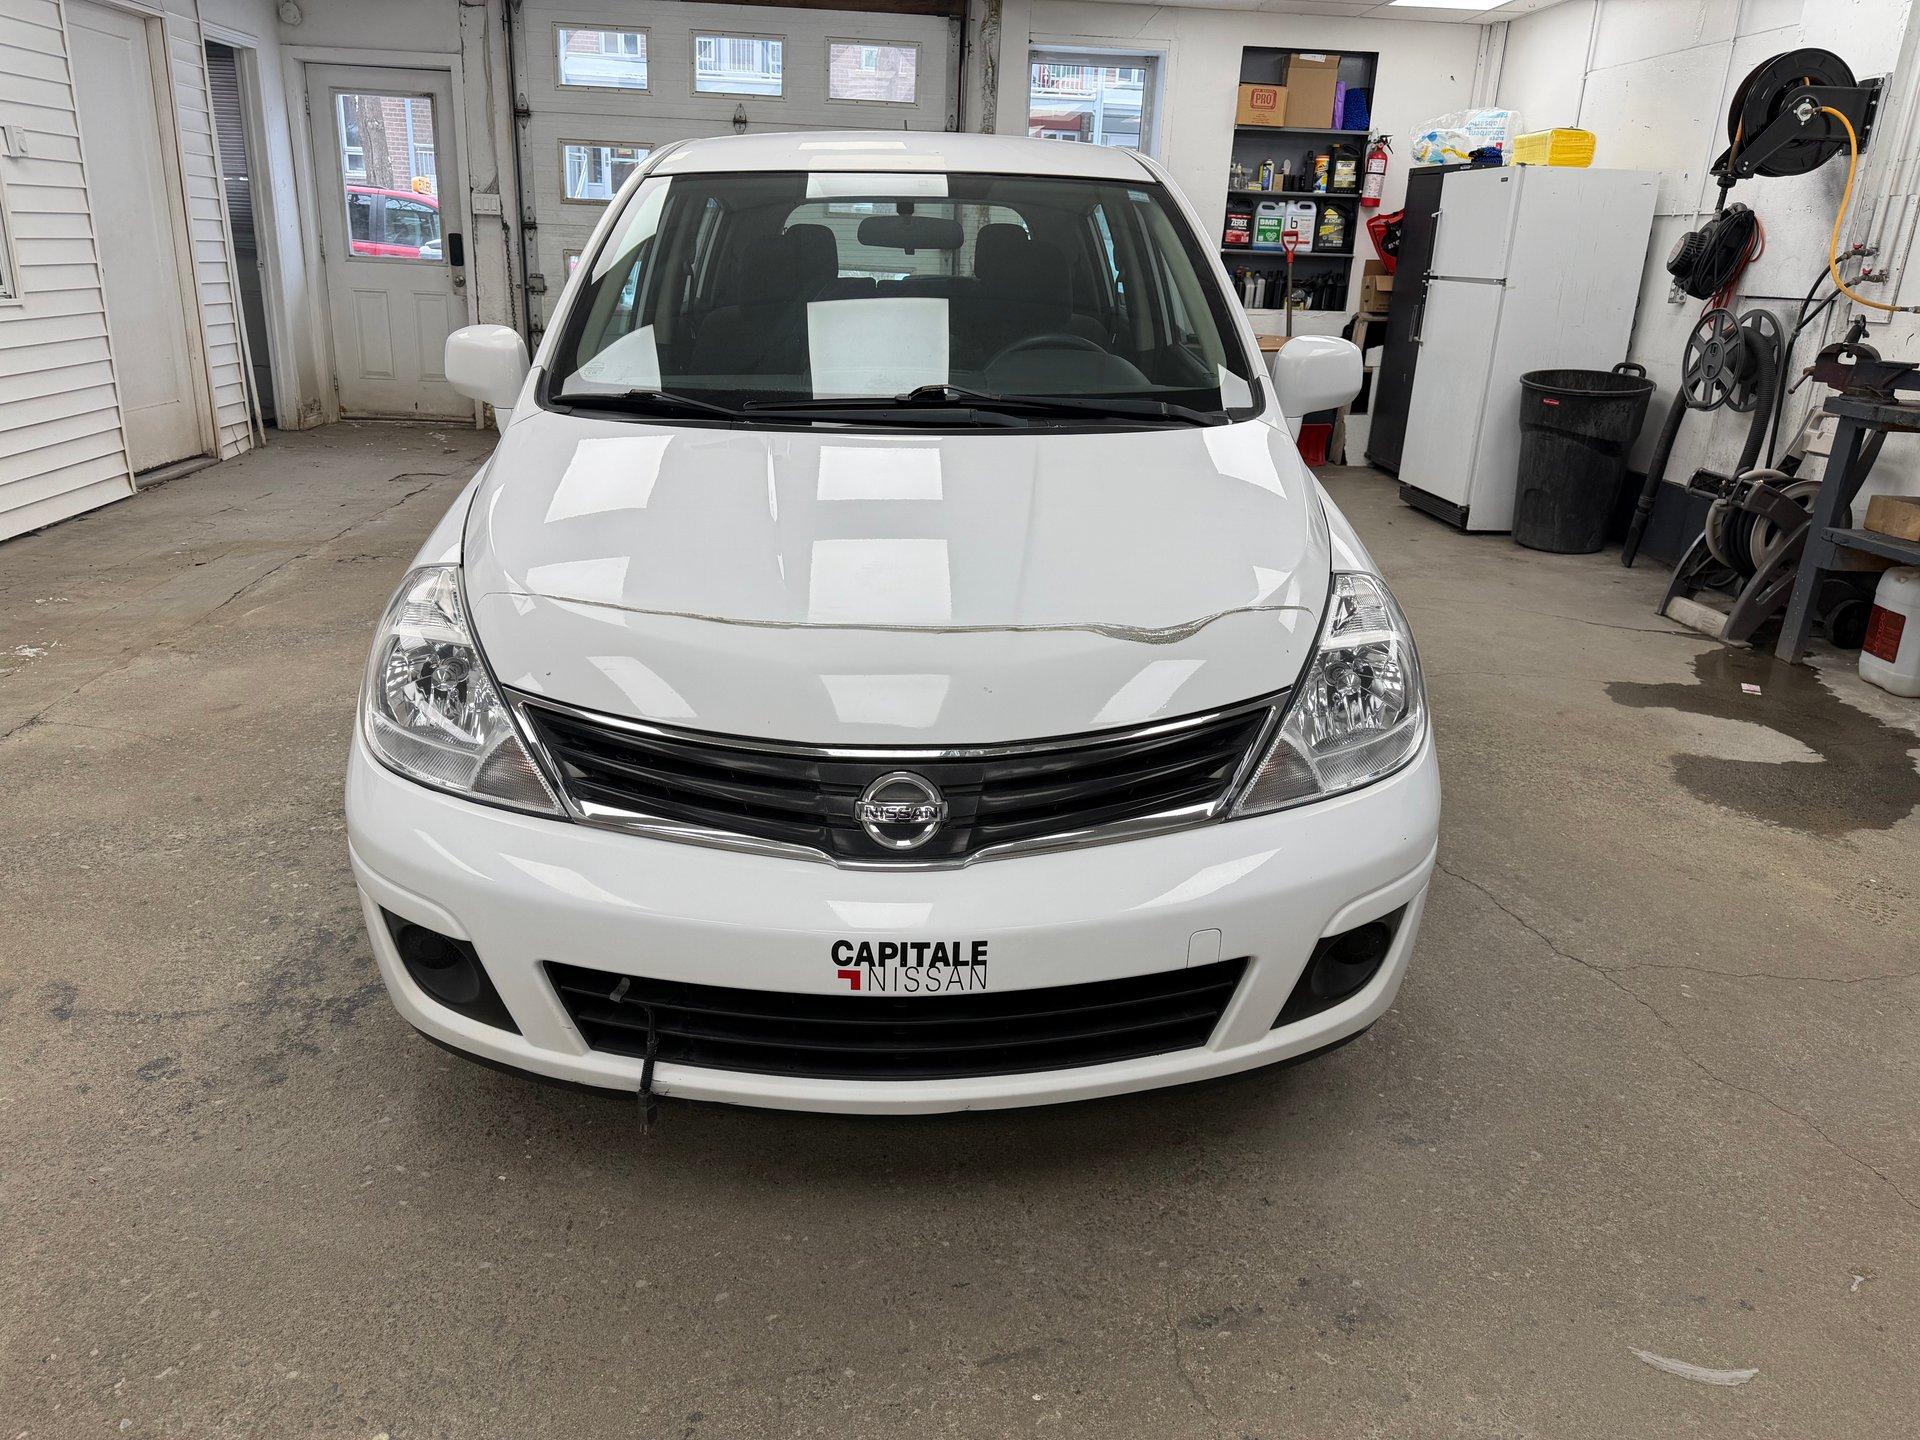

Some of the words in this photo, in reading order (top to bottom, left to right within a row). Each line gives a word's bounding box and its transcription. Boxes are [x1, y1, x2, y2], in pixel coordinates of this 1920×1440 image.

[1255, 93, 1272, 105] PRO
[1231, 218, 1248, 227] ZEREX
[1259, 218, 1278, 226] BMR
[864, 805, 938, 821] NISSAN
[831, 939, 989, 968] CAPITALE
[868, 966, 988, 993] NISSAN
